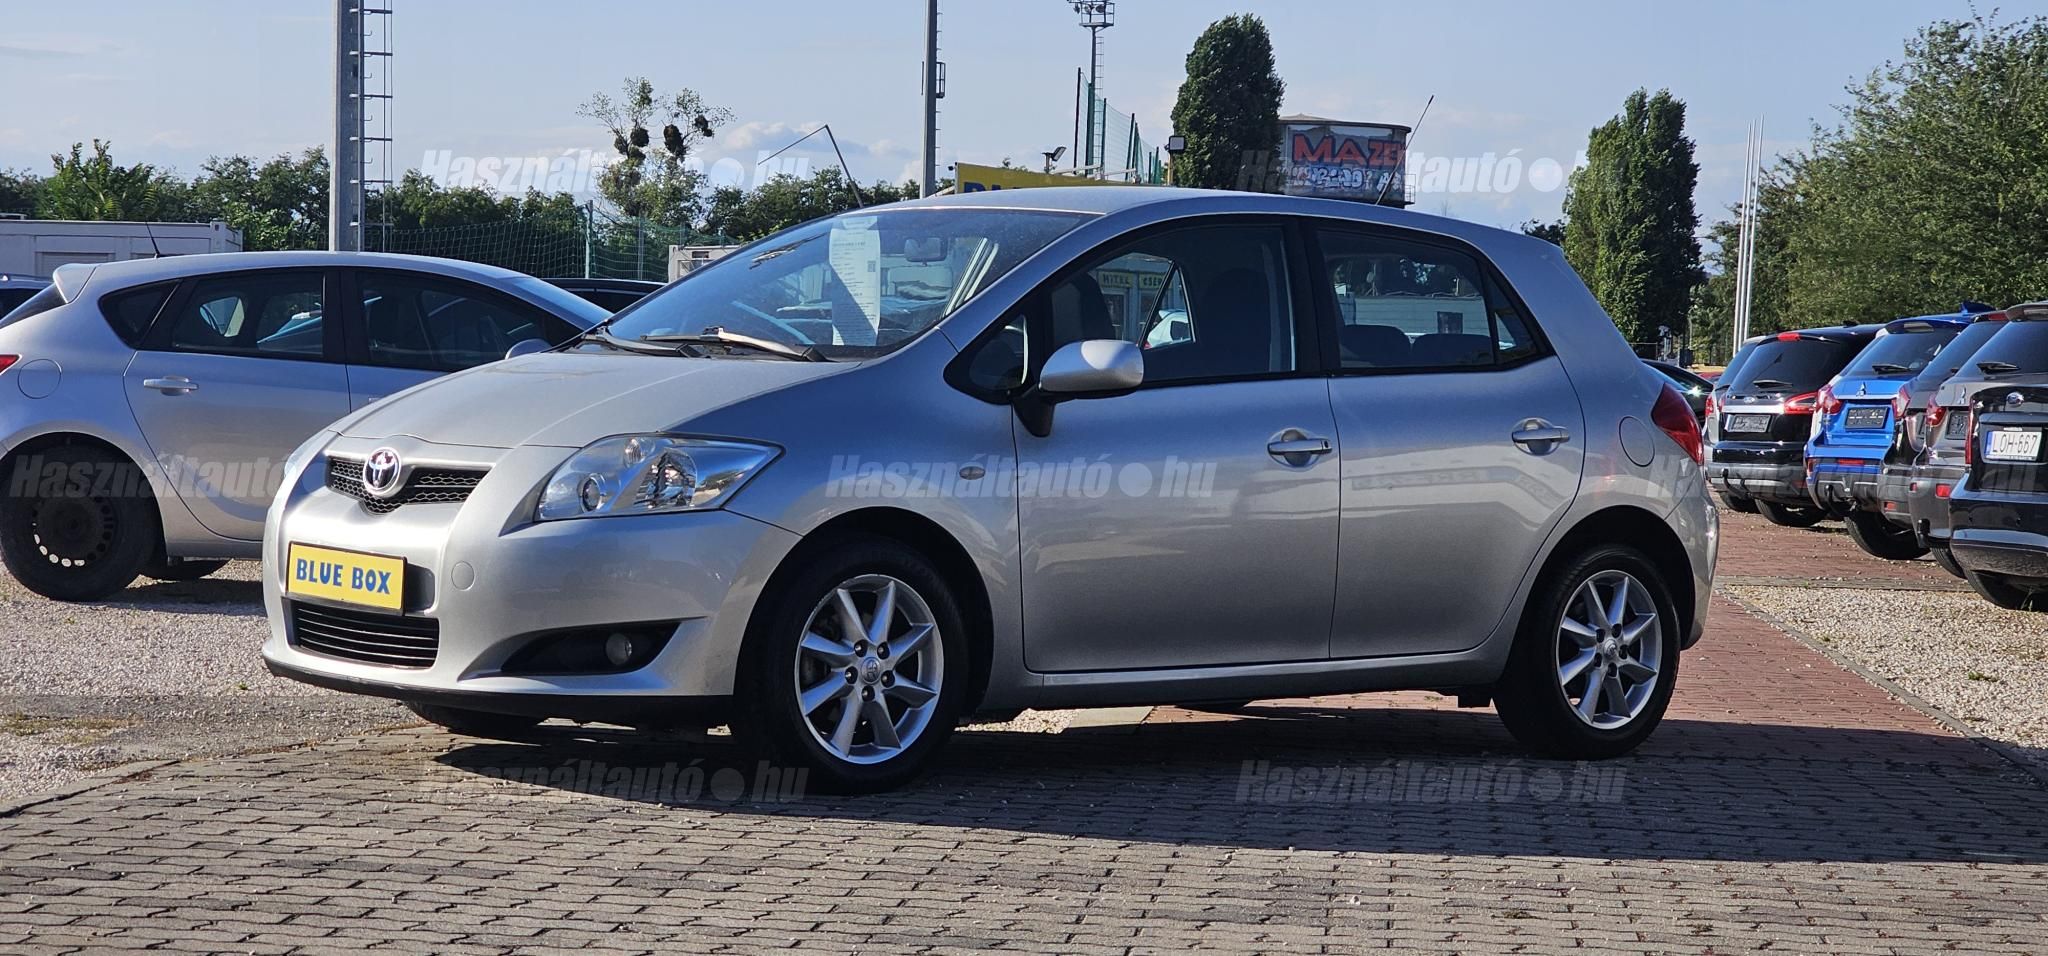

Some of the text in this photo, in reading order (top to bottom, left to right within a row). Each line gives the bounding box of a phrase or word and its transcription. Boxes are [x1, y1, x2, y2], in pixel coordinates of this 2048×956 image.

[1992, 433, 2038, 454] LOH-667
[296, 558, 393, 595] BLUE BOX
